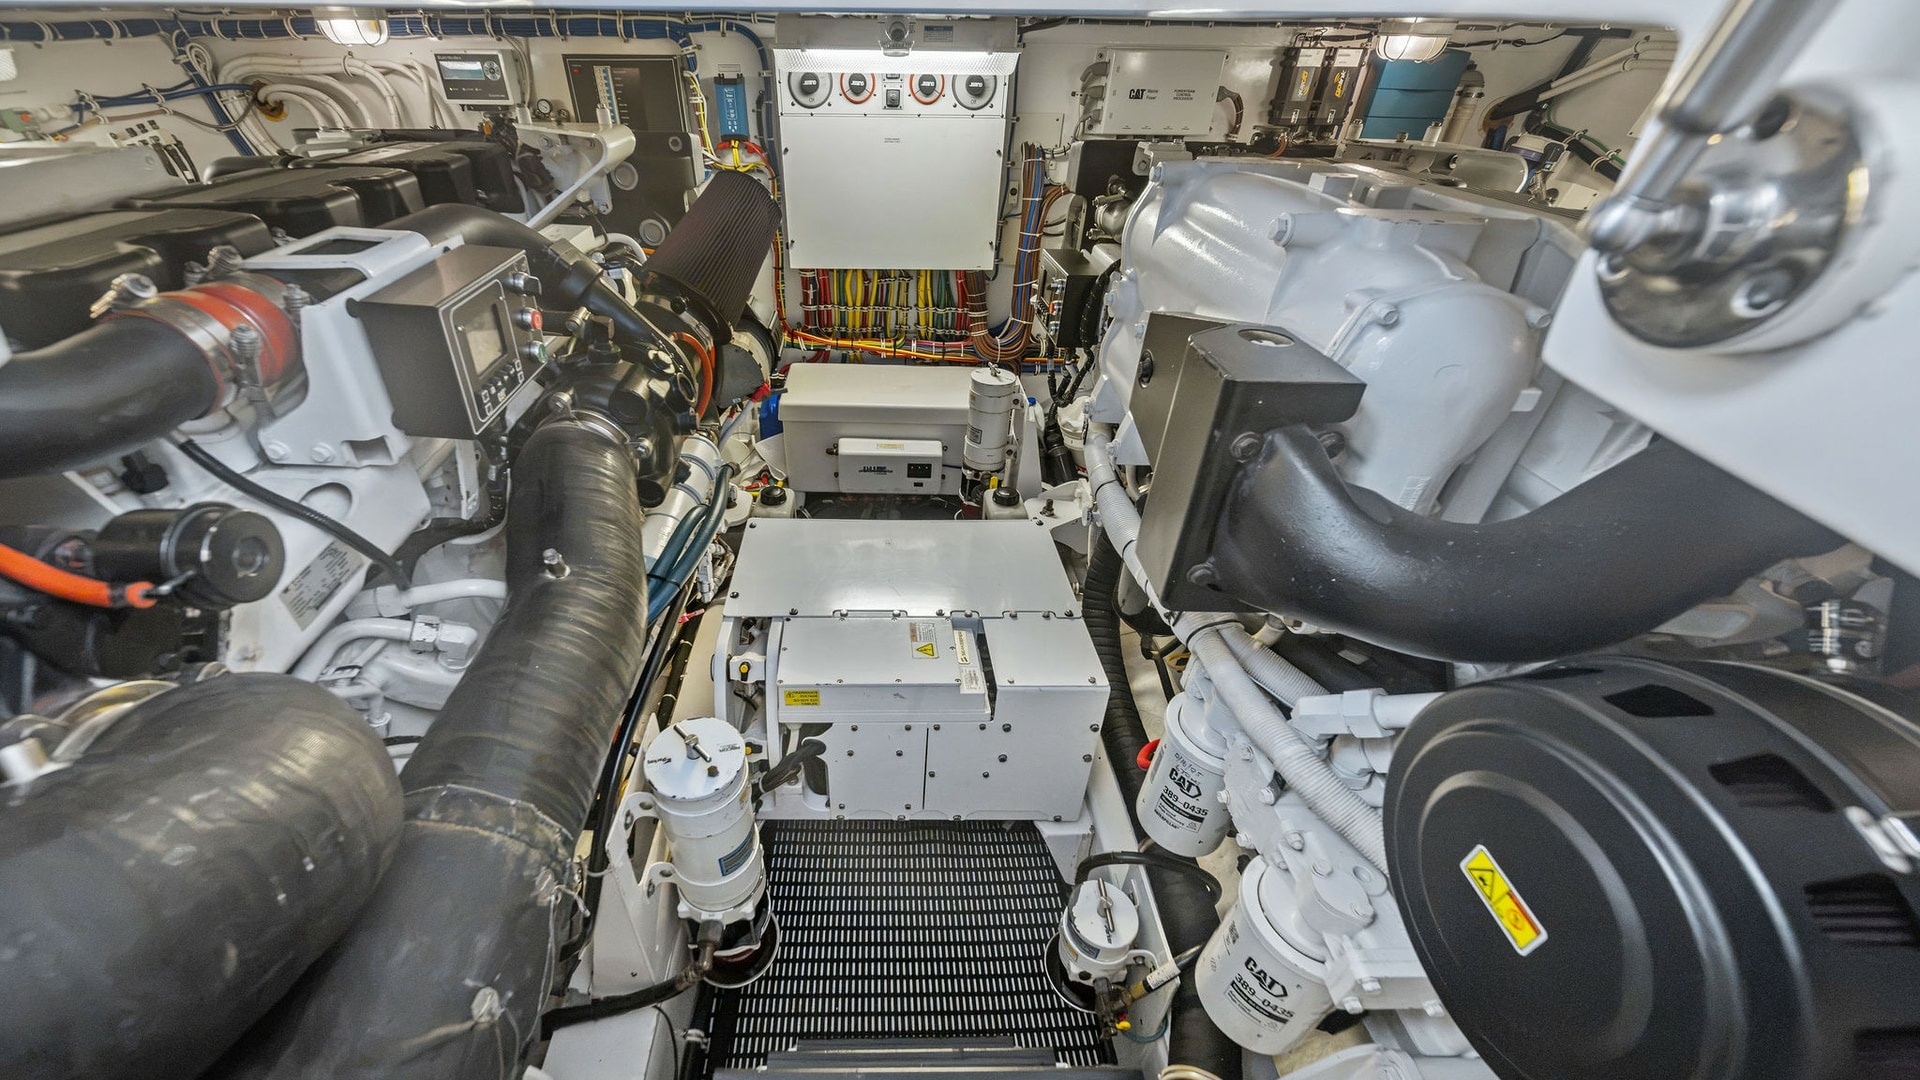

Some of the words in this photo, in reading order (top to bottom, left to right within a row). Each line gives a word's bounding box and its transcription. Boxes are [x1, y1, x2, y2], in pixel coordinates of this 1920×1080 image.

[1128, 88, 1146, 100] CAT
[1169, 767, 1199, 797] CAT
[1163, 785, 1208, 816] 389-0435
[1245, 956, 1285, 997] CAT
[1235, 973, 1295, 1018] 389-0435
